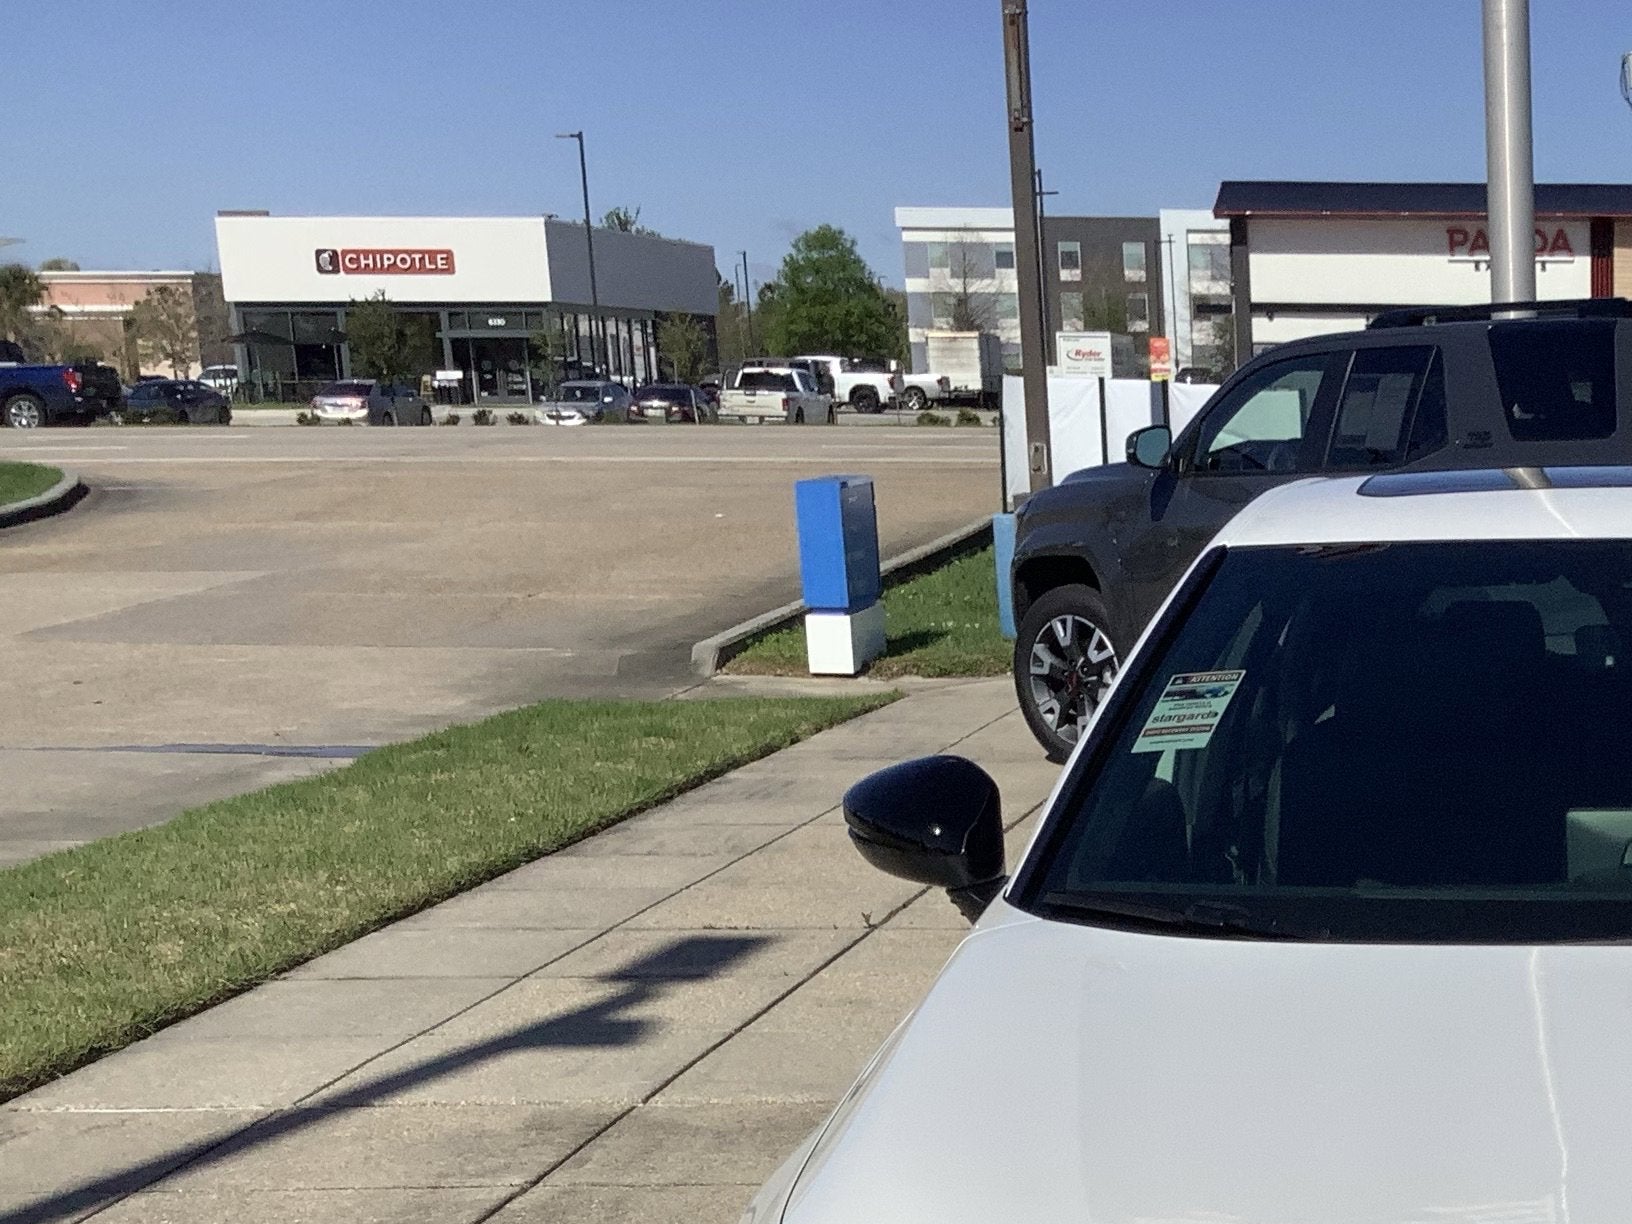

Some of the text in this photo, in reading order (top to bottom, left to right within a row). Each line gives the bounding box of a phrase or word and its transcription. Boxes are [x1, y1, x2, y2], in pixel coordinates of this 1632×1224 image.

[1446, 227, 1574, 256] PADA
[345, 253, 448, 269] CHIPOTLE
[1074, 349, 1102, 358] Ryder
[1190, 674, 1239, 682] ATTENTION
